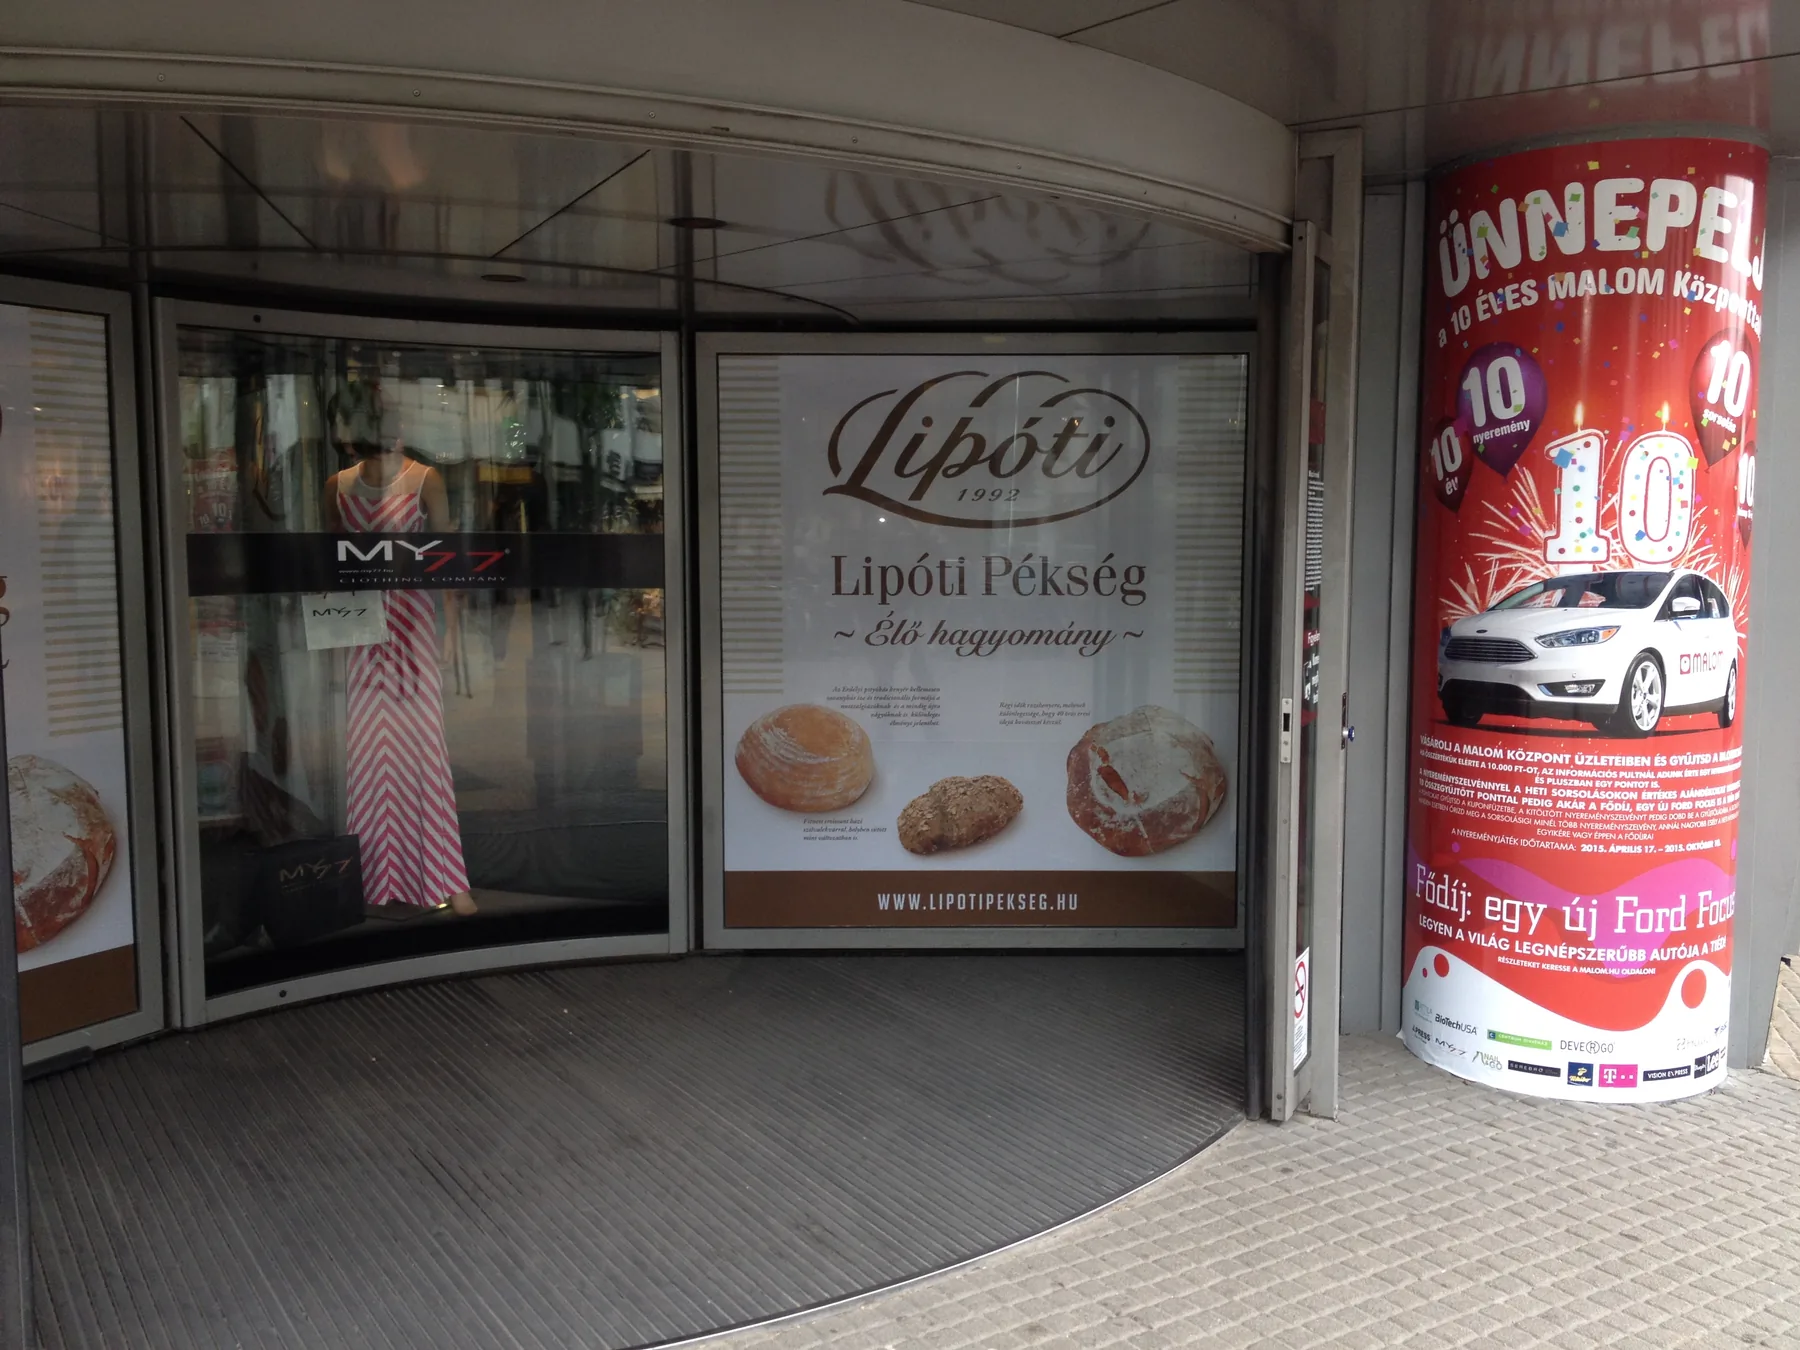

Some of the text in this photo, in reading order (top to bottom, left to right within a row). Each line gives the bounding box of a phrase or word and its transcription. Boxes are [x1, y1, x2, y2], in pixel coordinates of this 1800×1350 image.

[1438, 328, 1447, 348] a
[1450, 305, 1472, 335] 10
[1476, 279, 1539, 322] ÉVES
[1548, 267, 1665, 302] MALOM
[1706, 339, 1751, 417] 10
[1462, 356, 1526, 428] 10
[823, 371, 1126, 502] Lipóti
[1473, 419, 1531, 445] nyeremény
[1430, 426, 1462, 481] 10
[956, 487, 1021, 503] 1992
[1445, 477, 1459, 496] év
[1543, 428, 1696, 565] 10
[337, 540, 505, 573] MY77
[831, 553, 1147, 607] Lipóti Pékség
[864, 610, 1117, 658] Élő hagyomány
[1454, 743, 1460, 753] A
[1462, 744, 1504, 759] MALOM
[1506, 748, 1572, 764] KÖZPONT
[1575, 752, 1651, 767] ÜZLETEIBEN
[1654, 753, 1667, 767] ÉS
[1669, 752, 1712, 766] GYŰJTSD
[1712, 752, 1719, 763] A
[1458, 757, 1480, 768] ELÉRTE
[1480, 761, 1486, 769] A
[1488, 763, 1513, 771] 10.000
[1514, 765, 1540, 775] FT-OT,
[1541, 767, 1554, 775] AZ
[1555, 768, 1618, 778] INFORMÁCIÓS
[1619, 769, 1656, 779] PULTNÁL
[1656, 770, 1683, 779] ADUNK
[1513, 785, 1521, 793] A
[1525, 786, 1548, 796] HETI
[1551, 788, 1638, 800] SORSOLÁSOKON
[1641, 789, 1678, 800] ÉRTÉKES
[1534, 774, 1545, 784] ÉS
[1546, 778, 1593, 787] PLUSZBAN
[1595, 780, 1613, 788] EGY
[1614, 780, 1650, 788] PONTOT
[1467, 800, 1516, 814] KUPONFÜZETBE,
[1526, 808, 1563, 818] KITÖLTÖTT
[1565, 812, 1647, 821] NYEREMÉNYSZELVÉNYT
[1669, 812, 1686, 820] DOBD
[1477, 792, 1519, 804] PONTTAL
[1522, 797, 1553, 807] PEDIG
[1556, 799, 1586, 810] AKÁR
[1588, 801, 1597, 810] A
[1600, 800, 1633, 812] FŐDÍJ,
[1636, 802, 1655, 812] EGY
[1657, 800, 1669, 811] ÚJ
[1670, 801, 1693, 811] FORD
[1695, 799, 1716, 809] FOCUS
[1465, 810, 1480, 818] MEG
[1533, 818, 1557, 828] MINÉL
[1558, 820, 1578, 829] TÖBB
[1579, 822, 1657, 831] NYEREMÉNYSZELVÉNY,
[1658, 822, 1680, 831] ANNÁL
[1457, 829, 1519, 845] NYEREMÉNYJÁTÉK
[1520, 838, 1577, 851] IDŐTARTAMA:
[1580, 844, 1607, 853] 2015.
[1608, 843, 1643, 853] ÁPRILIS
[1644, 845, 1657, 854] 17.
[1664, 844, 1686, 853] 2015.
[1536, 828, 1571, 838] EGYIKÉRE
[1572, 831, 1593, 839] VAGY
[1593, 831, 1617, 840] ÉPPEN
[877, 892, 1079, 912] WWW.LIPOTIPEKSEG.HU
[1415, 863, 1472, 922] Fődíj:
[1485, 896, 1548, 933] egy
[1562, 895, 1598, 941] új
[1614, 895, 1687, 934] Ford
[1418, 913, 1453, 938] LEGYEN
[1455, 930, 1465, 942] A
[1467, 931, 1511, 951] VILÁG
[1514, 940, 1648, 962] LEGNÉPSZERŰBB
[1650, 942, 1700, 961] AUTÓJA
[1701, 944, 1709, 956] A
[1497, 956, 1541, 970] RÉSZLETEKET
[1541, 962, 1571, 973] KERESSE
[1572, 965, 1579, 973] A
[1579, 966, 1620, 975] MALOM.HU
[1434, 1013, 1478, 1036] BioTechUSA
[1647, 1071, 1667, 1079] VISION
